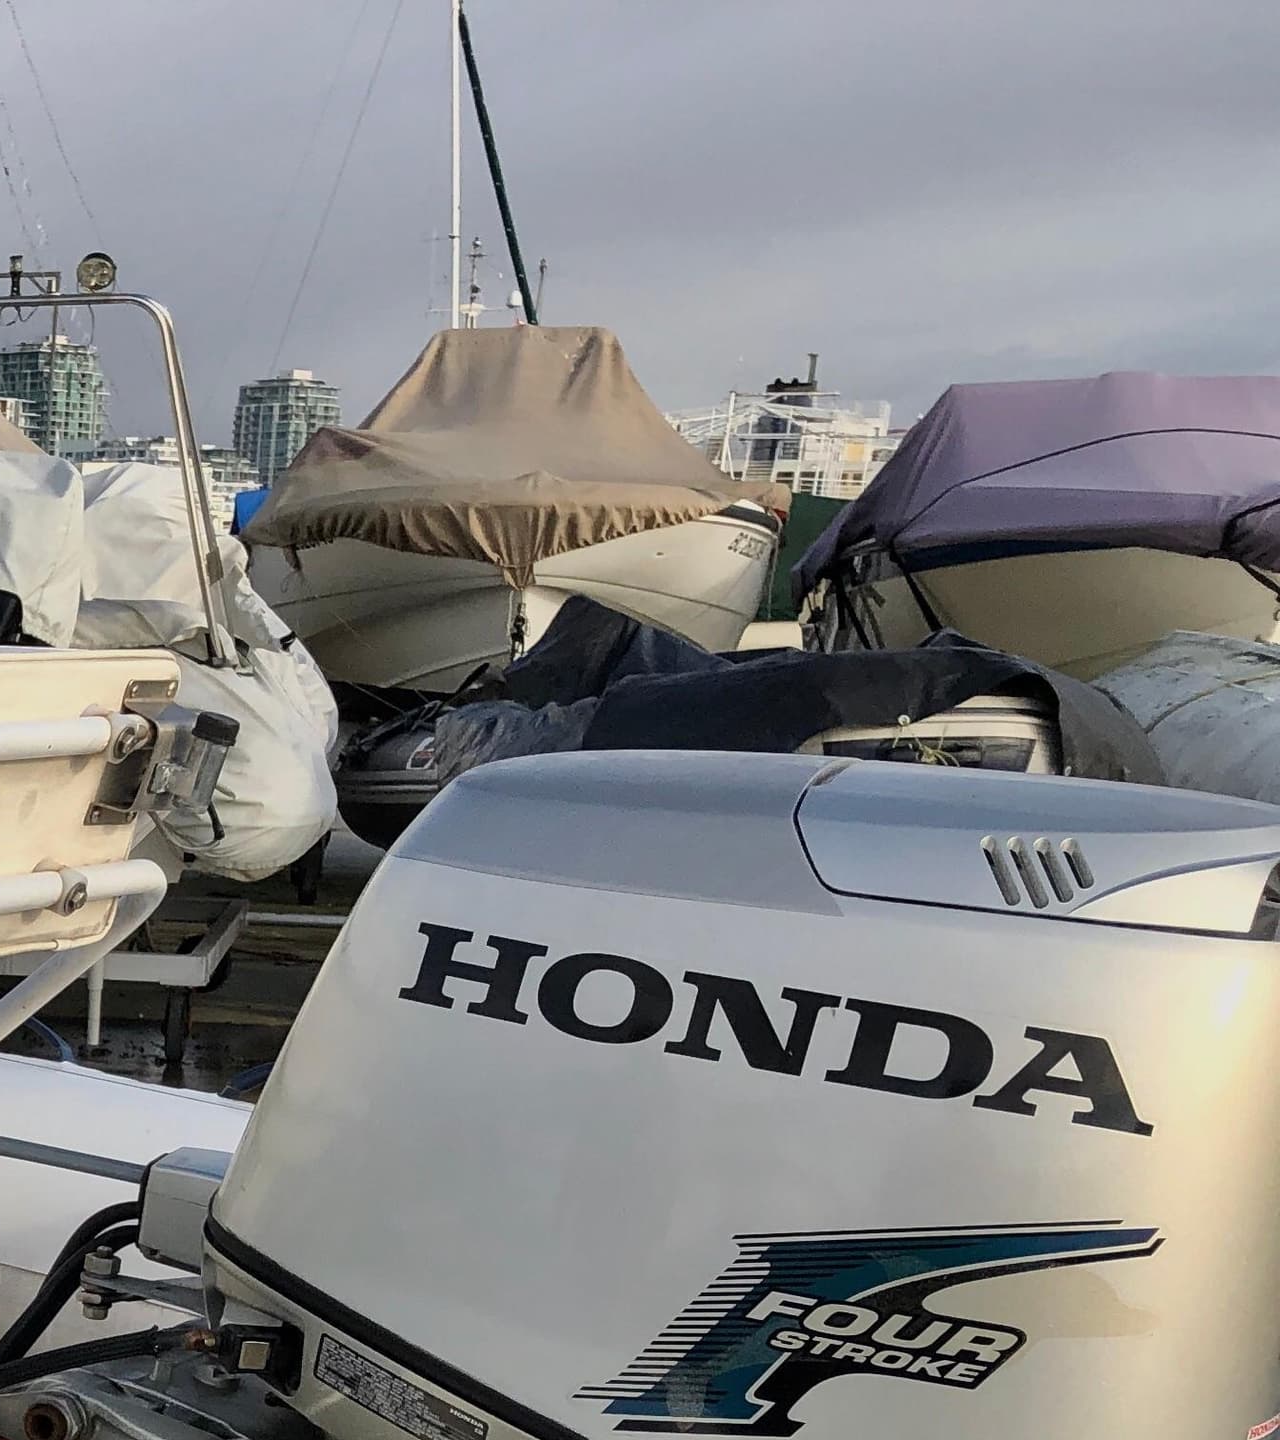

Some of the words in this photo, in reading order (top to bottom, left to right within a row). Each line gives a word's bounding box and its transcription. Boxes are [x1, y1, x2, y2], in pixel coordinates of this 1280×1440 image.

[399, 922, 1154, 1136] HONDA
[746, 1291, 1019, 1363] FOUR
[770, 1331, 987, 1383] STROKE
